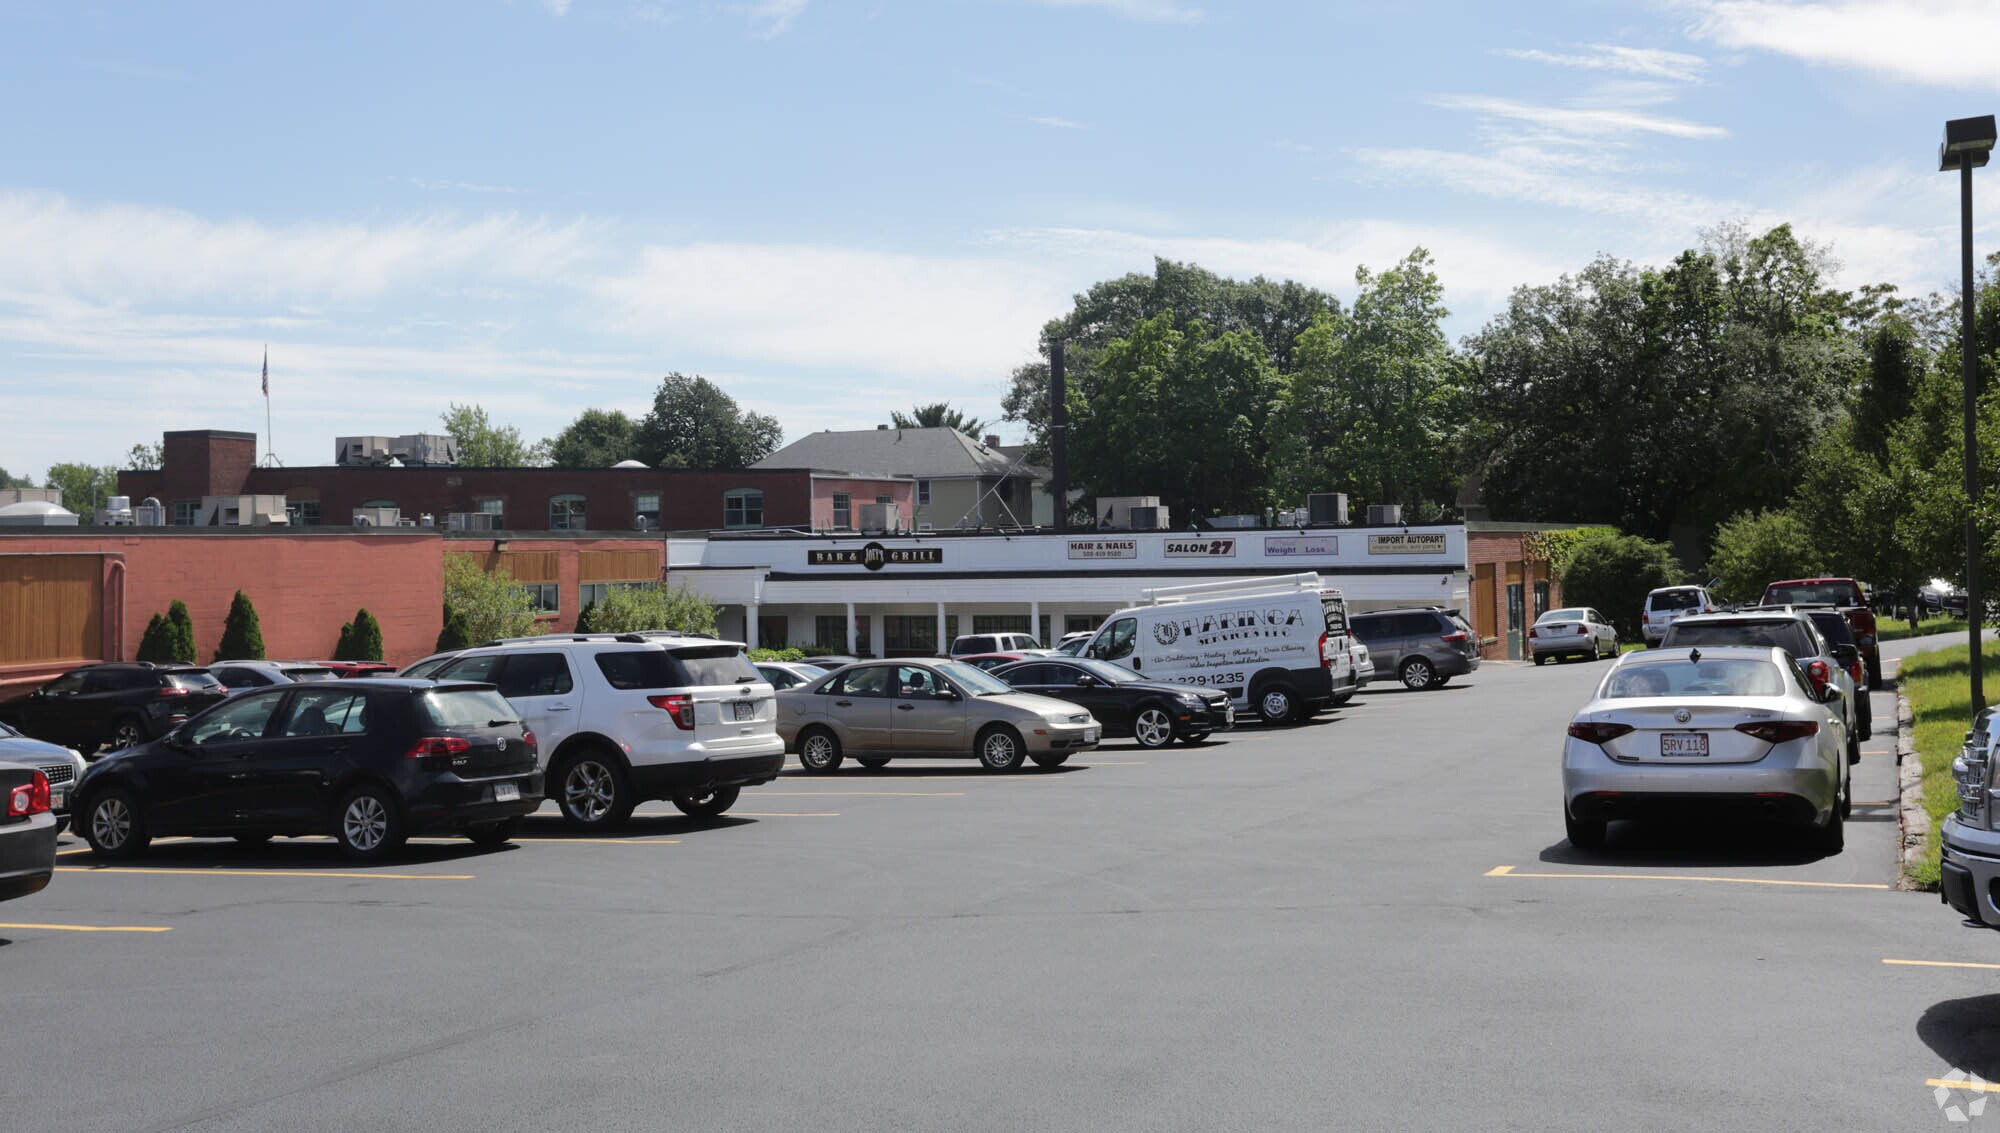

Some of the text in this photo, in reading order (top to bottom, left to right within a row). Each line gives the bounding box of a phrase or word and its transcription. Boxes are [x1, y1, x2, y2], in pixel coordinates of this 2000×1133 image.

[1378, 536, 1404, 544] IMPORT
[1407, 535, 1444, 544] AUTOPART
[1106, 542, 1134, 550] NAILS
[1167, 540, 1233, 555] SALON 27
[1267, 546, 1296, 555] Weight
[816, 551, 935, 561] BAR & GRILL
[1182, 609, 1305, 637] HARINGA
[1199, 627, 1260, 646] SERVICES
[1663, 739, 1706, 751] 5RV 118
